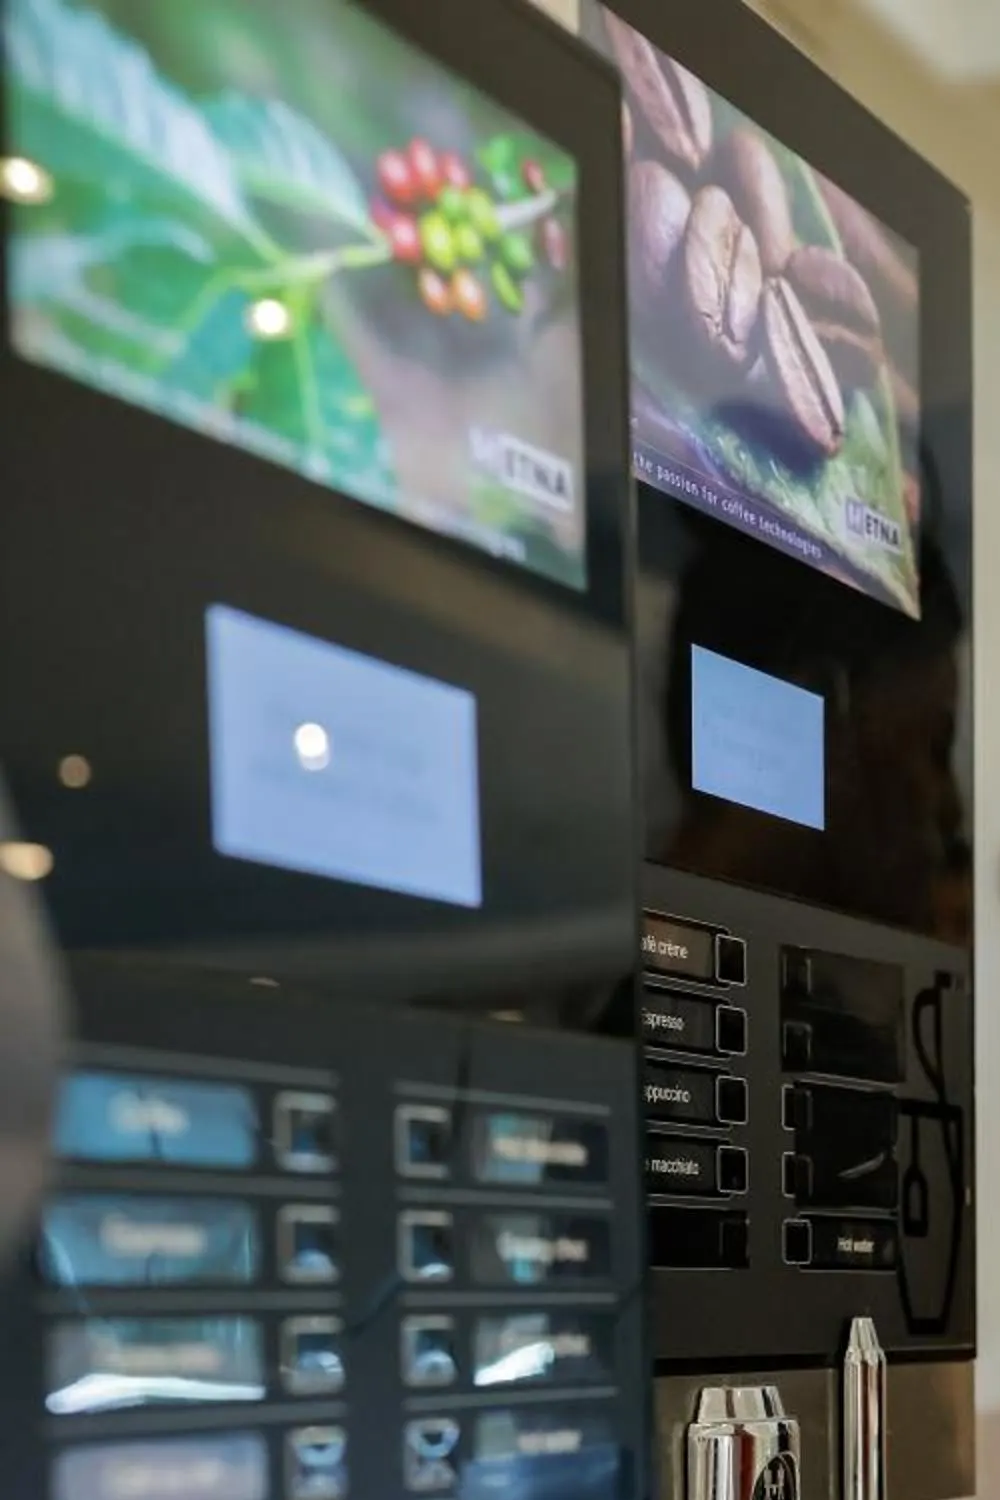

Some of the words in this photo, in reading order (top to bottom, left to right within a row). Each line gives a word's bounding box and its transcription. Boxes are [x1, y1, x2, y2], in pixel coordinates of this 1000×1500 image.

[504, 447, 567, 496] ETNA
[657, 465, 699, 496] passion
[702, 485, 719, 506] for
[721, 497, 757, 526] coffee
[758, 515, 823, 559] technologies
[865, 520, 899, 547] ETNA
[641, 935, 657, 953] afé
[651, 1158, 700, 1176] macchiato
